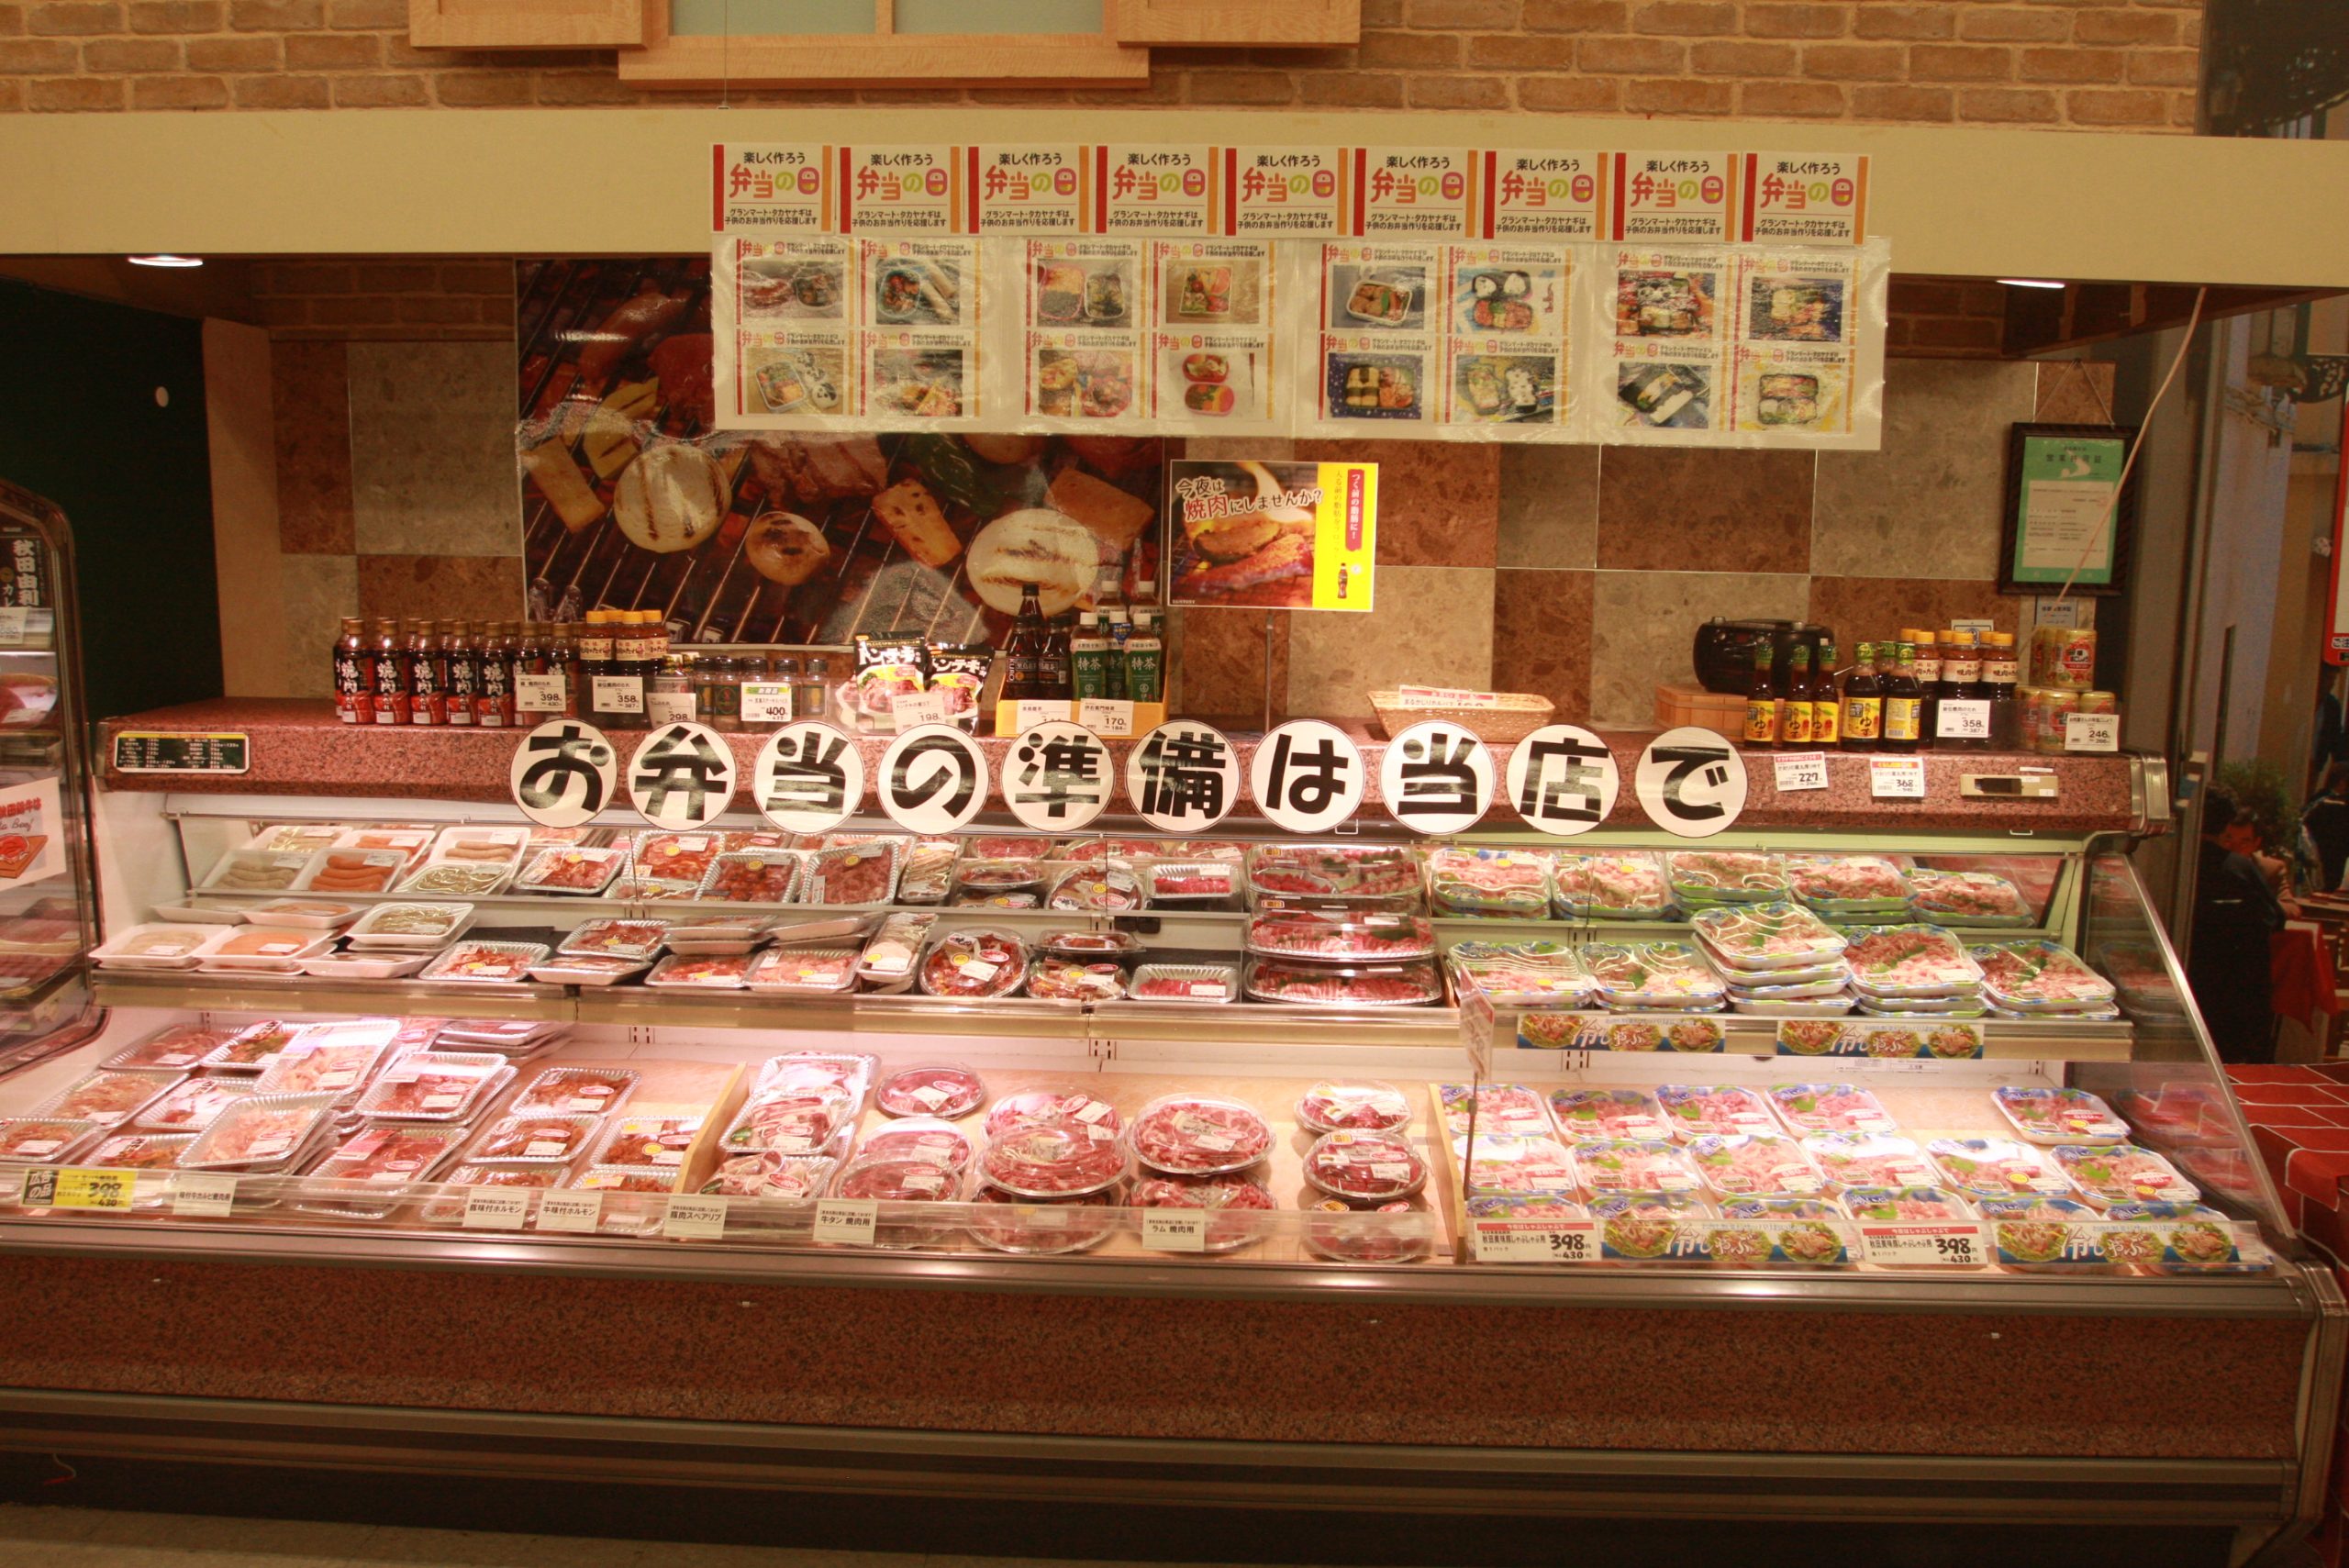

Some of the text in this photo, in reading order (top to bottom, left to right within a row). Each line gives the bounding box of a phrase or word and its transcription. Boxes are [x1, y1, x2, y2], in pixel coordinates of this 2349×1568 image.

[744, 152, 805, 164] 楽しく作ろう
[871, 154, 933, 166] 楽しく作ろう
[998, 153, 1063, 165] 楽しく作ろう
[1128, 153, 1191, 166] 楽しく作ろう
[1257, 155, 1320, 167] 楽しく作ろう
[1386, 156, 1450, 169] 楽しく作ろう
[1516, 159, 1580, 172] 楽しく作ろう
[1646, 161, 1710, 173] 楽しく作ろう
[1776, 162, 1842, 175] 楽しく作ろう
[1176, 478, 1224, 497] 今夜は
[1077, 657, 1101, 671] 特茶
[1131, 657, 1156, 671] 特茶
[766, 706, 785, 716] 400
[919, 713, 939, 721] 198
[1962, 719, 1981, 728] 358
[2088, 730, 2108, 739] 246
[518, 725, 1731, 823] お弁当の準備は当店で
[28, 1170, 53, 1186] 広告
[28, 1183, 53, 1198] の品
[88, 1183, 122, 1198] 398
[469, 1204, 522, 1213] 豚味付ホルモン
[542, 1206, 596, 1217] 牛味付ホルモン
[670, 1211, 722, 1222] 豚肉スペアリブ
[820, 1216, 871, 1226] 牛タン 焼肉用
[1152, 1225, 1195, 1234] ラム 焼肉用
